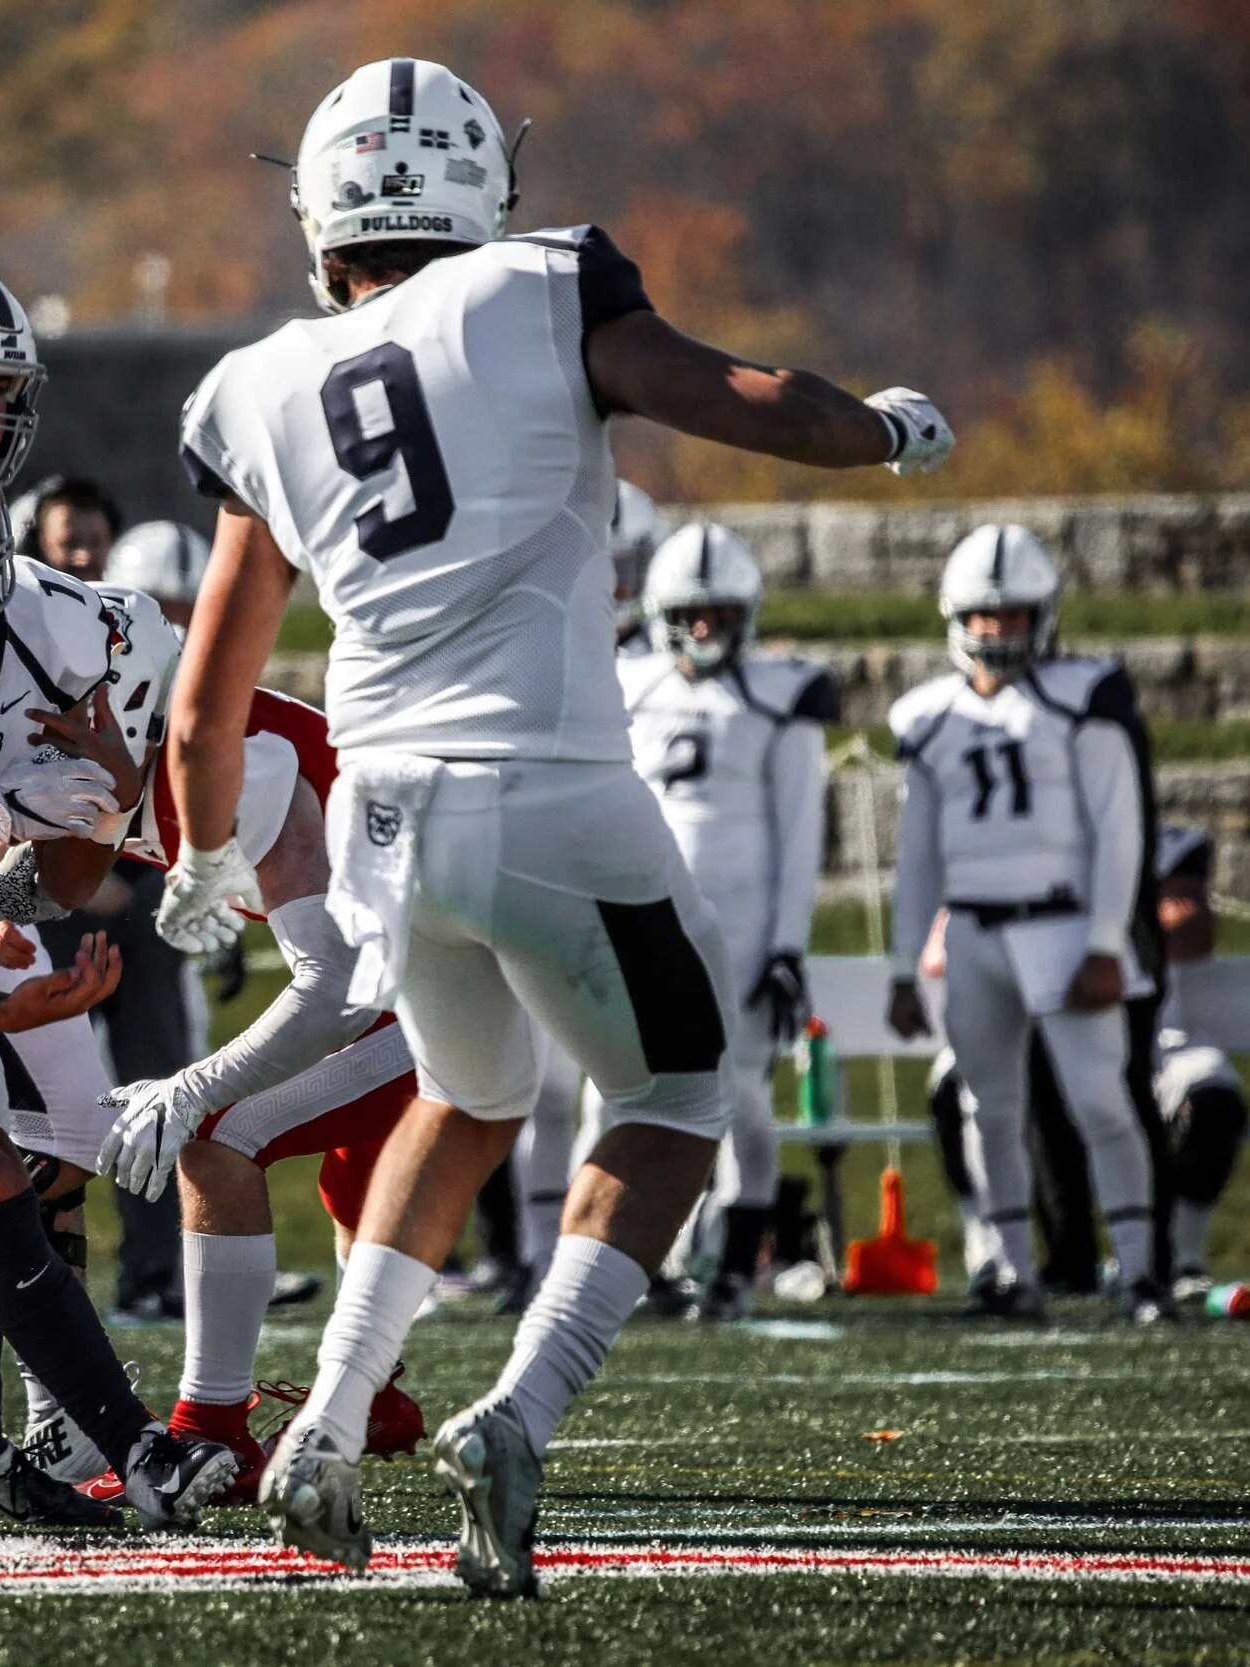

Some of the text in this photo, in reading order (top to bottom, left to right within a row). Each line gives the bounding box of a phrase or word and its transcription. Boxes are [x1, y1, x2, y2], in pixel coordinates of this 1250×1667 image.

[361, 215, 453, 232] BULLDOGS
[321, 341, 456, 562] 9
[964, 740, 1032, 820] 11
